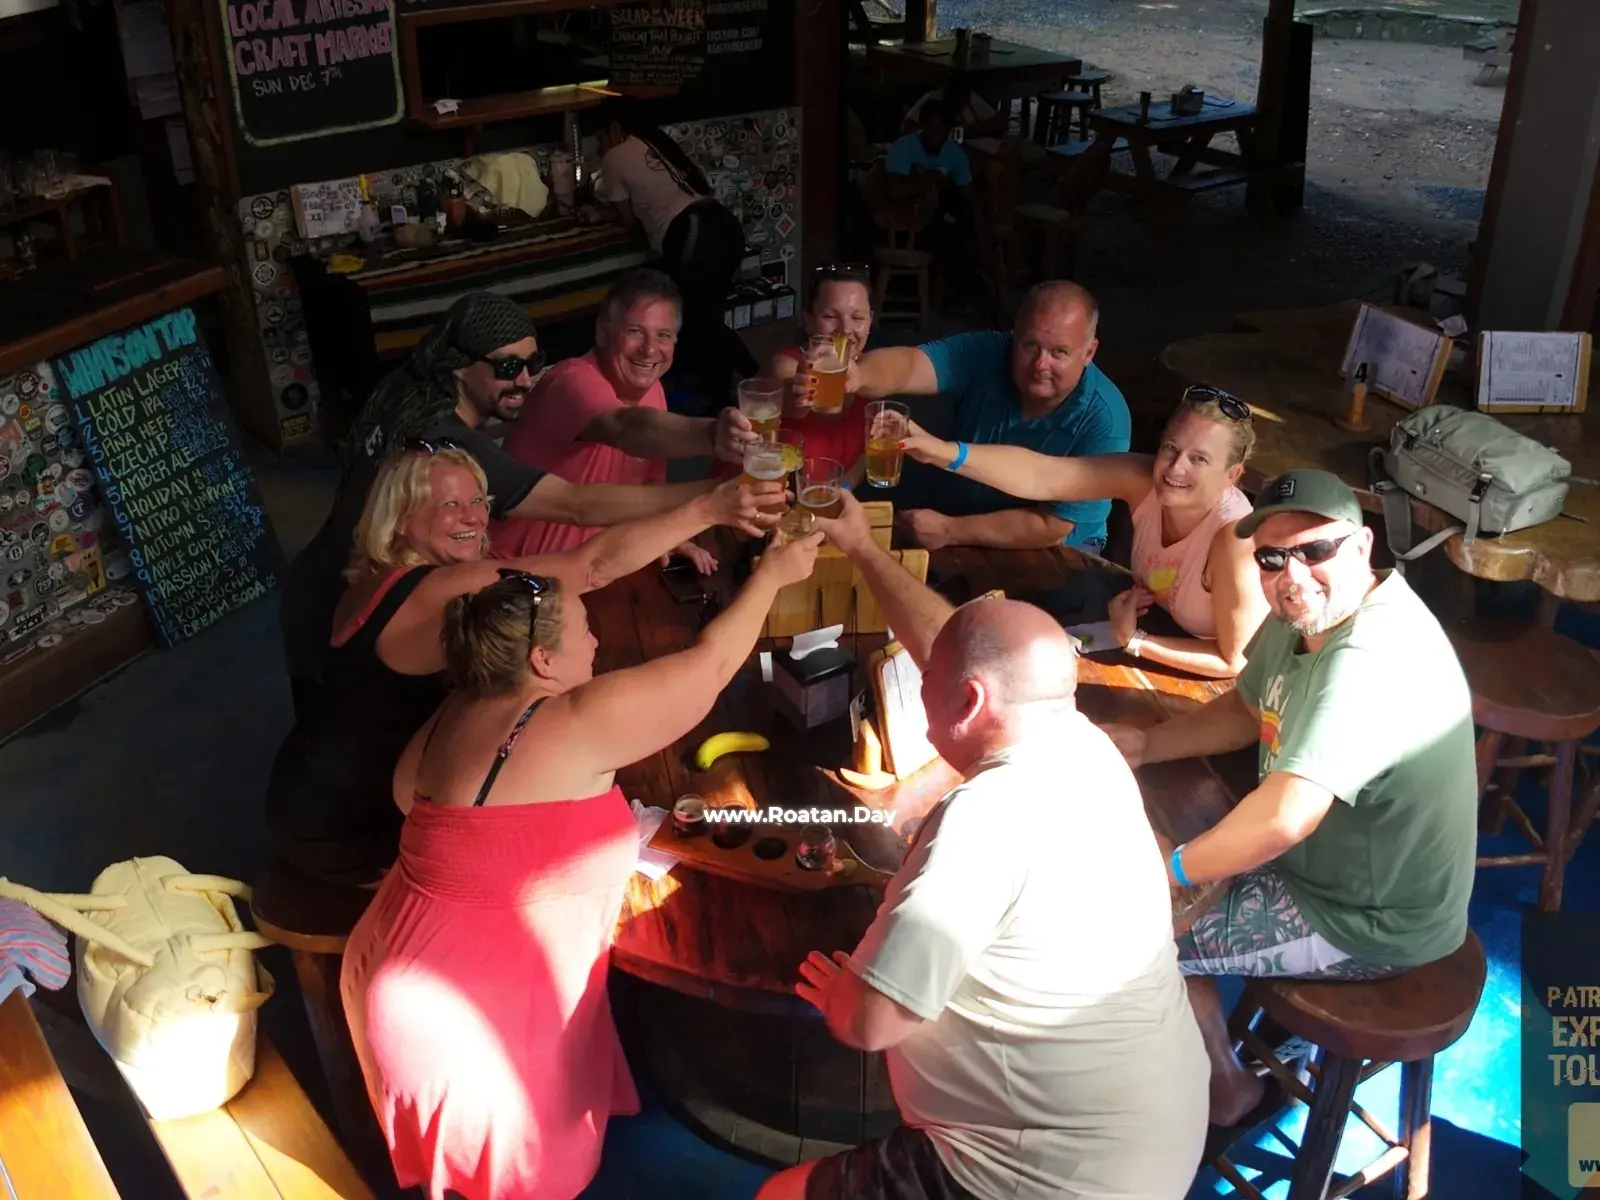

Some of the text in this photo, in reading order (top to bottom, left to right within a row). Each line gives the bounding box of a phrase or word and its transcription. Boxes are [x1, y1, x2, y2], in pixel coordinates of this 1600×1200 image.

[229, 0, 299, 37] LOCAL
[663, 8, 705, 27] WEEK
[233, 21, 391, 75] CRAFT MARKET
[252, 77, 284, 97] SUN
[288, 72, 316, 92] DEC
[86, 386, 135, 420] LATIN
[131, 360, 182, 397] LAGER
[1354, 362, 1368, 383] 4
[95, 404, 136, 437] COLD
[140, 396, 167, 418] IPA
[108, 440, 158, 481] CZECH
[118, 457, 171, 502] AMBER
[170, 446, 196, 472] ALE
[124, 474, 192, 520] HOLIDAY
[133, 505, 181, 542] NITRO
[181, 476, 236, 515] PUMPKIN
[143, 520, 197, 565] AUTUMN
[151, 549, 187, 584] APPLE
[187, 524, 231, 557] CIDER
[157, 554, 213, 601] PASSION
[174, 571, 251, 628] KOMBUCHA
[183, 598, 231, 639] CREAM
[231, 579, 268, 609] SODA
